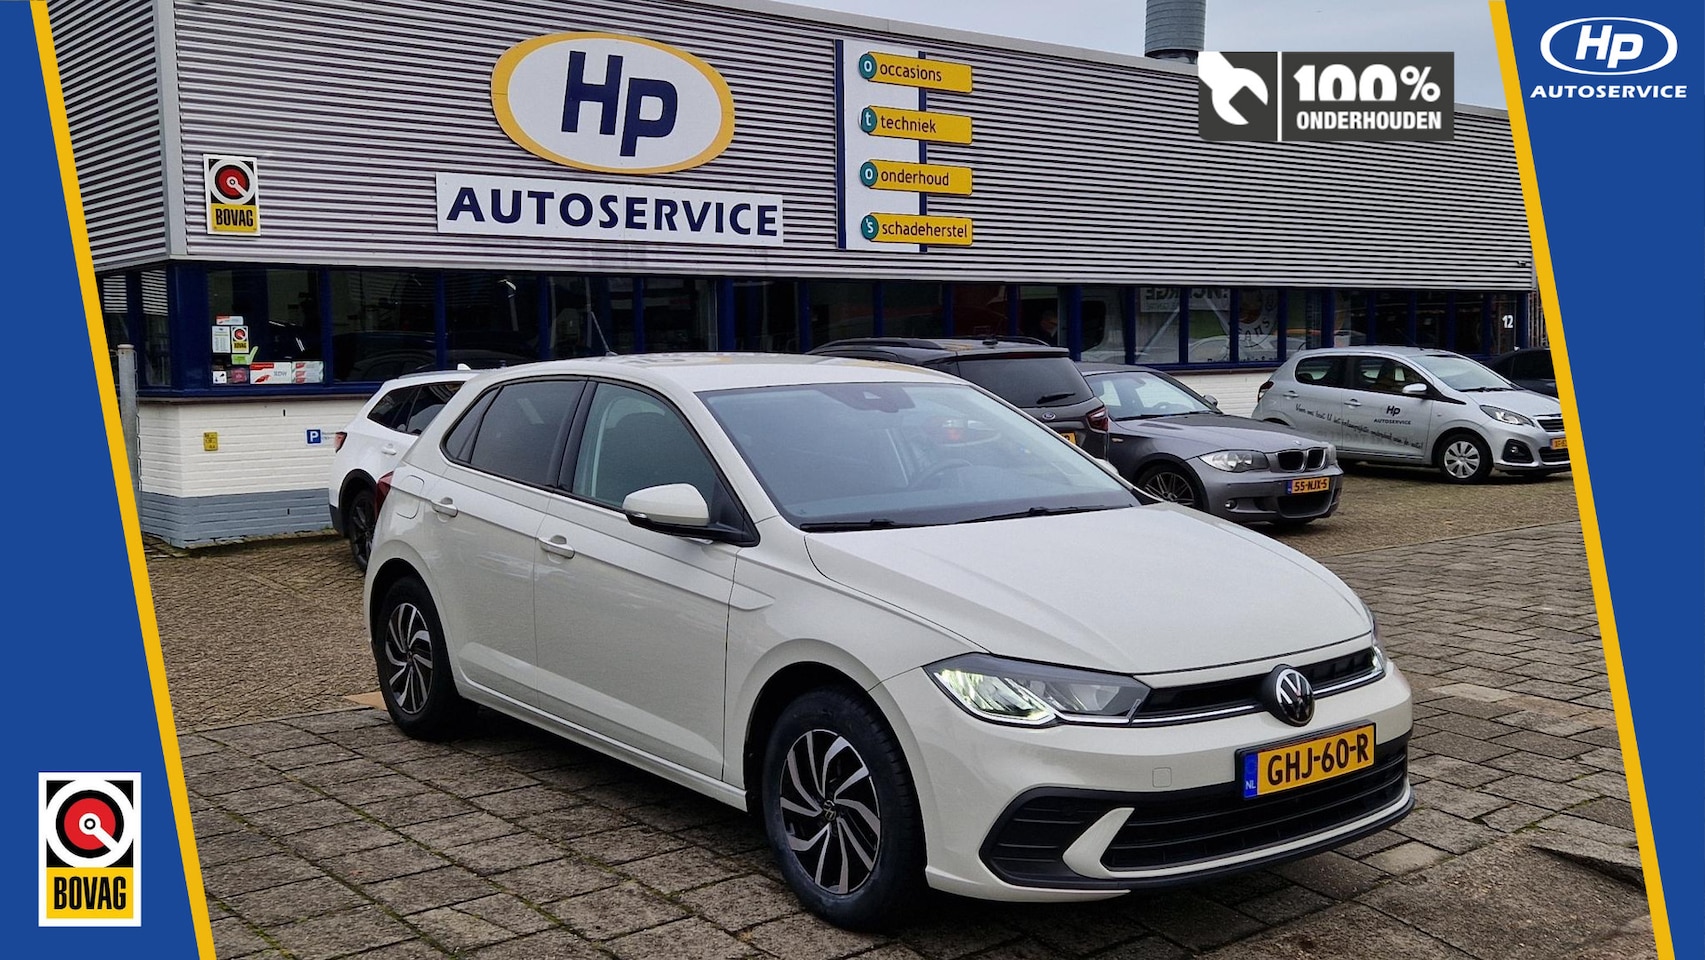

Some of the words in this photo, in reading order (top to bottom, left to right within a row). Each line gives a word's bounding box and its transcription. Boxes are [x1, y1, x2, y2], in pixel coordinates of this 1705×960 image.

[880, 63, 942, 82] occasions
[881, 115, 936, 133] techniek
[881, 168, 949, 186] onderhoud
[215, 208, 254, 227] BOVAG
[447, 187, 778, 237] AUTOSERVICE
[882, 221, 968, 238] schadeherstel
[1502, 314, 1514, 329] 12
[1245, 780, 1256, 790] NL
[1267, 733, 1369, 786] GHJ-60-R
